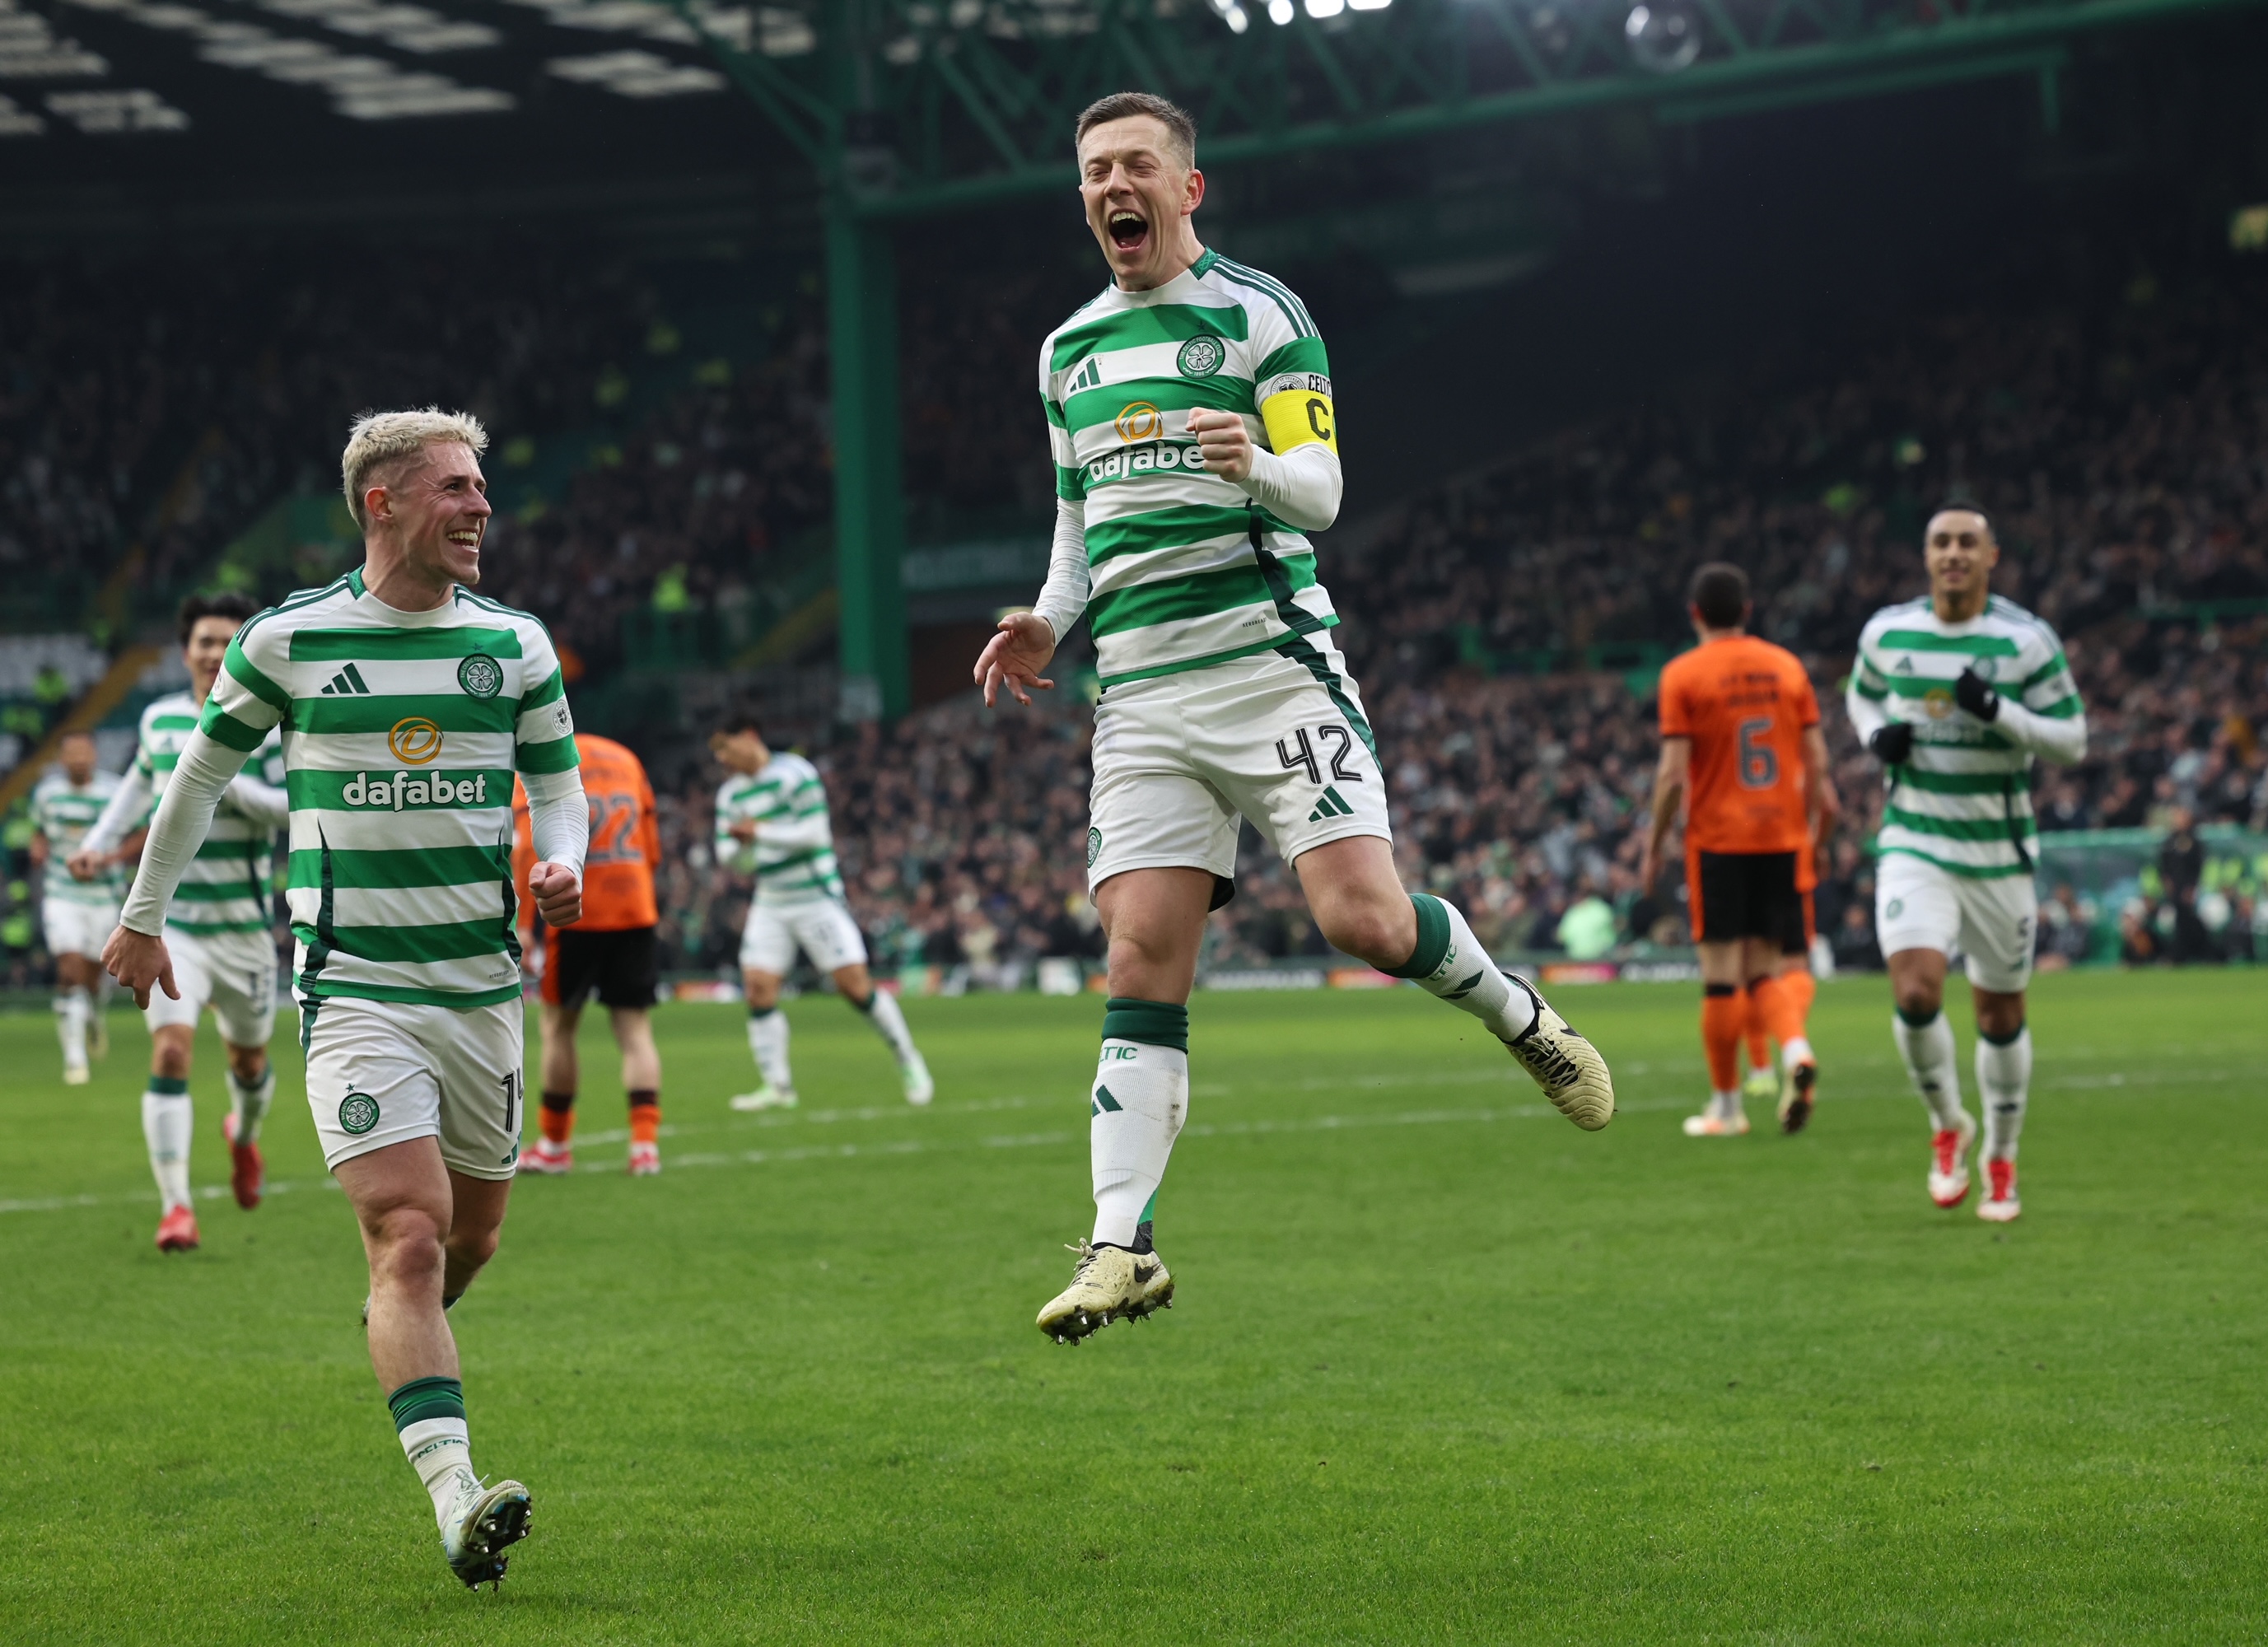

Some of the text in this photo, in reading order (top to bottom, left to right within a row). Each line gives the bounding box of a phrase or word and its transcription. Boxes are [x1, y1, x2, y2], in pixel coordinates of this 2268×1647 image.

[1306, 398, 1331, 441] C
[1089, 441, 1204, 483] dafabe
[1275, 725, 1363, 785] 42
[1737, 715, 1779, 790] 6
[342, 769, 486, 813] dafabet
